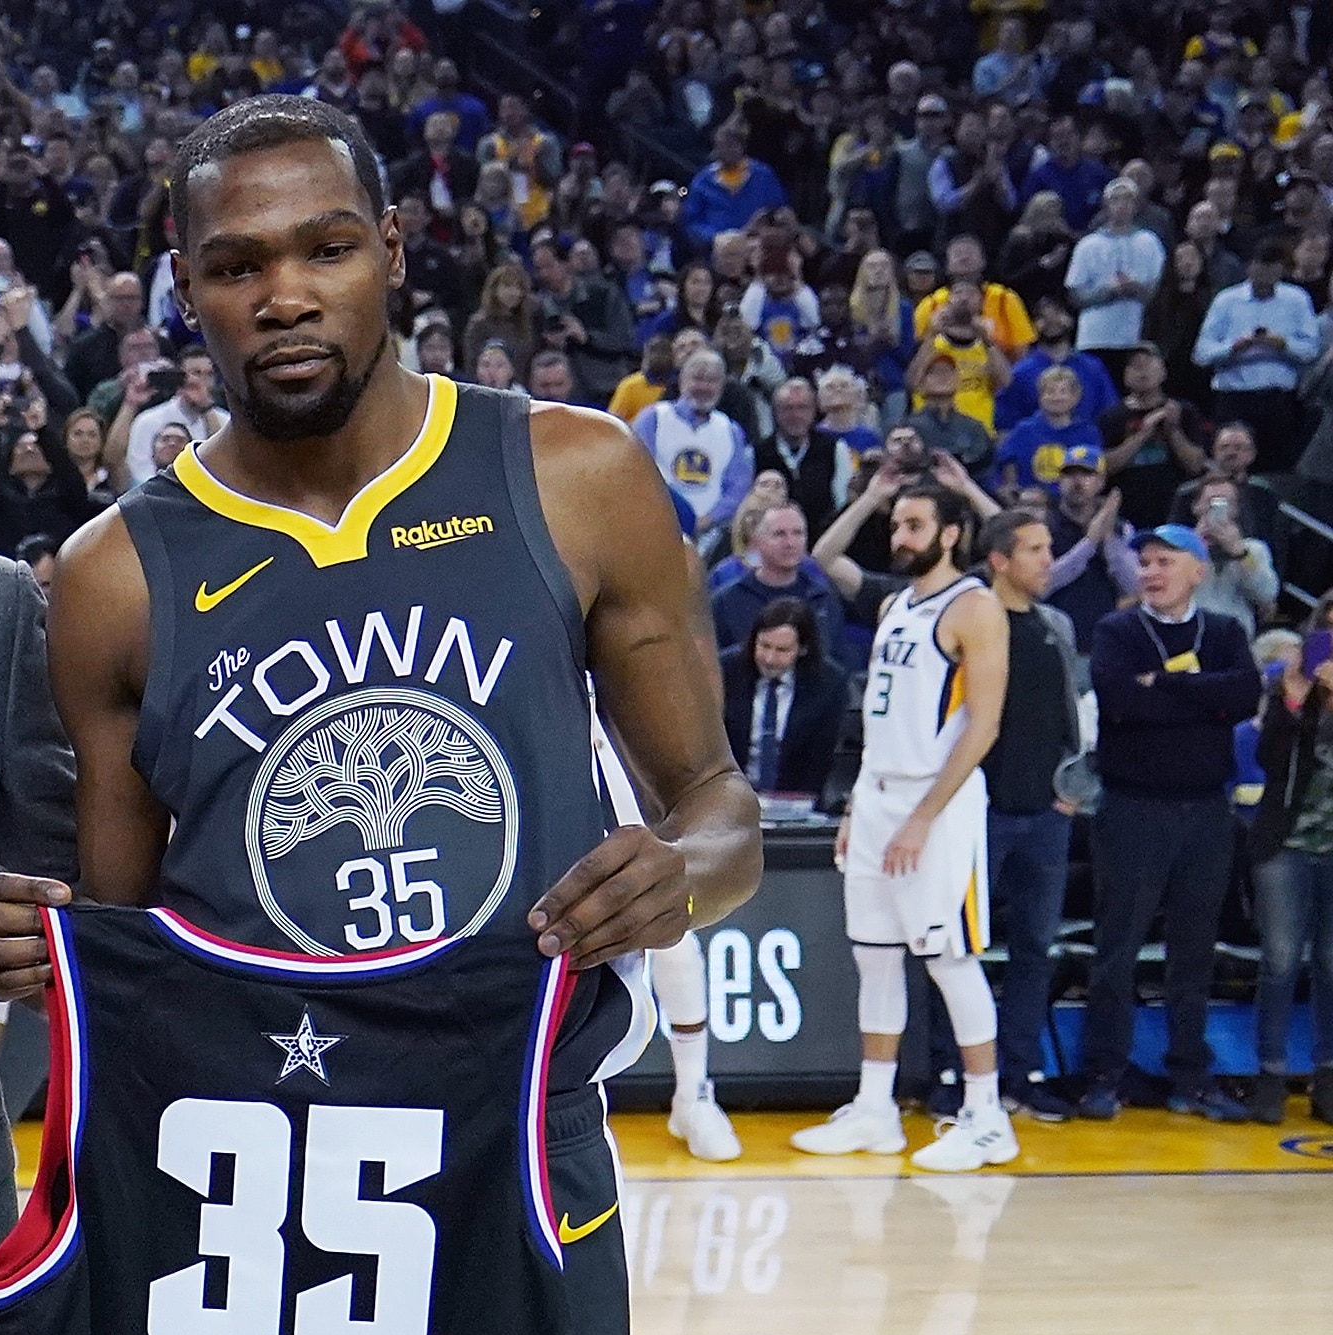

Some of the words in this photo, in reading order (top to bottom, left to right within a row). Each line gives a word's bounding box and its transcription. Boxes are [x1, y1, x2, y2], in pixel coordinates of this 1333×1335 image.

[390, 514, 494, 551] Rakuten
[193, 605, 513, 754] TOWN
[207, 646, 251, 692] The
[871, 671, 893, 717] 3
[335, 847, 446, 950] 35
